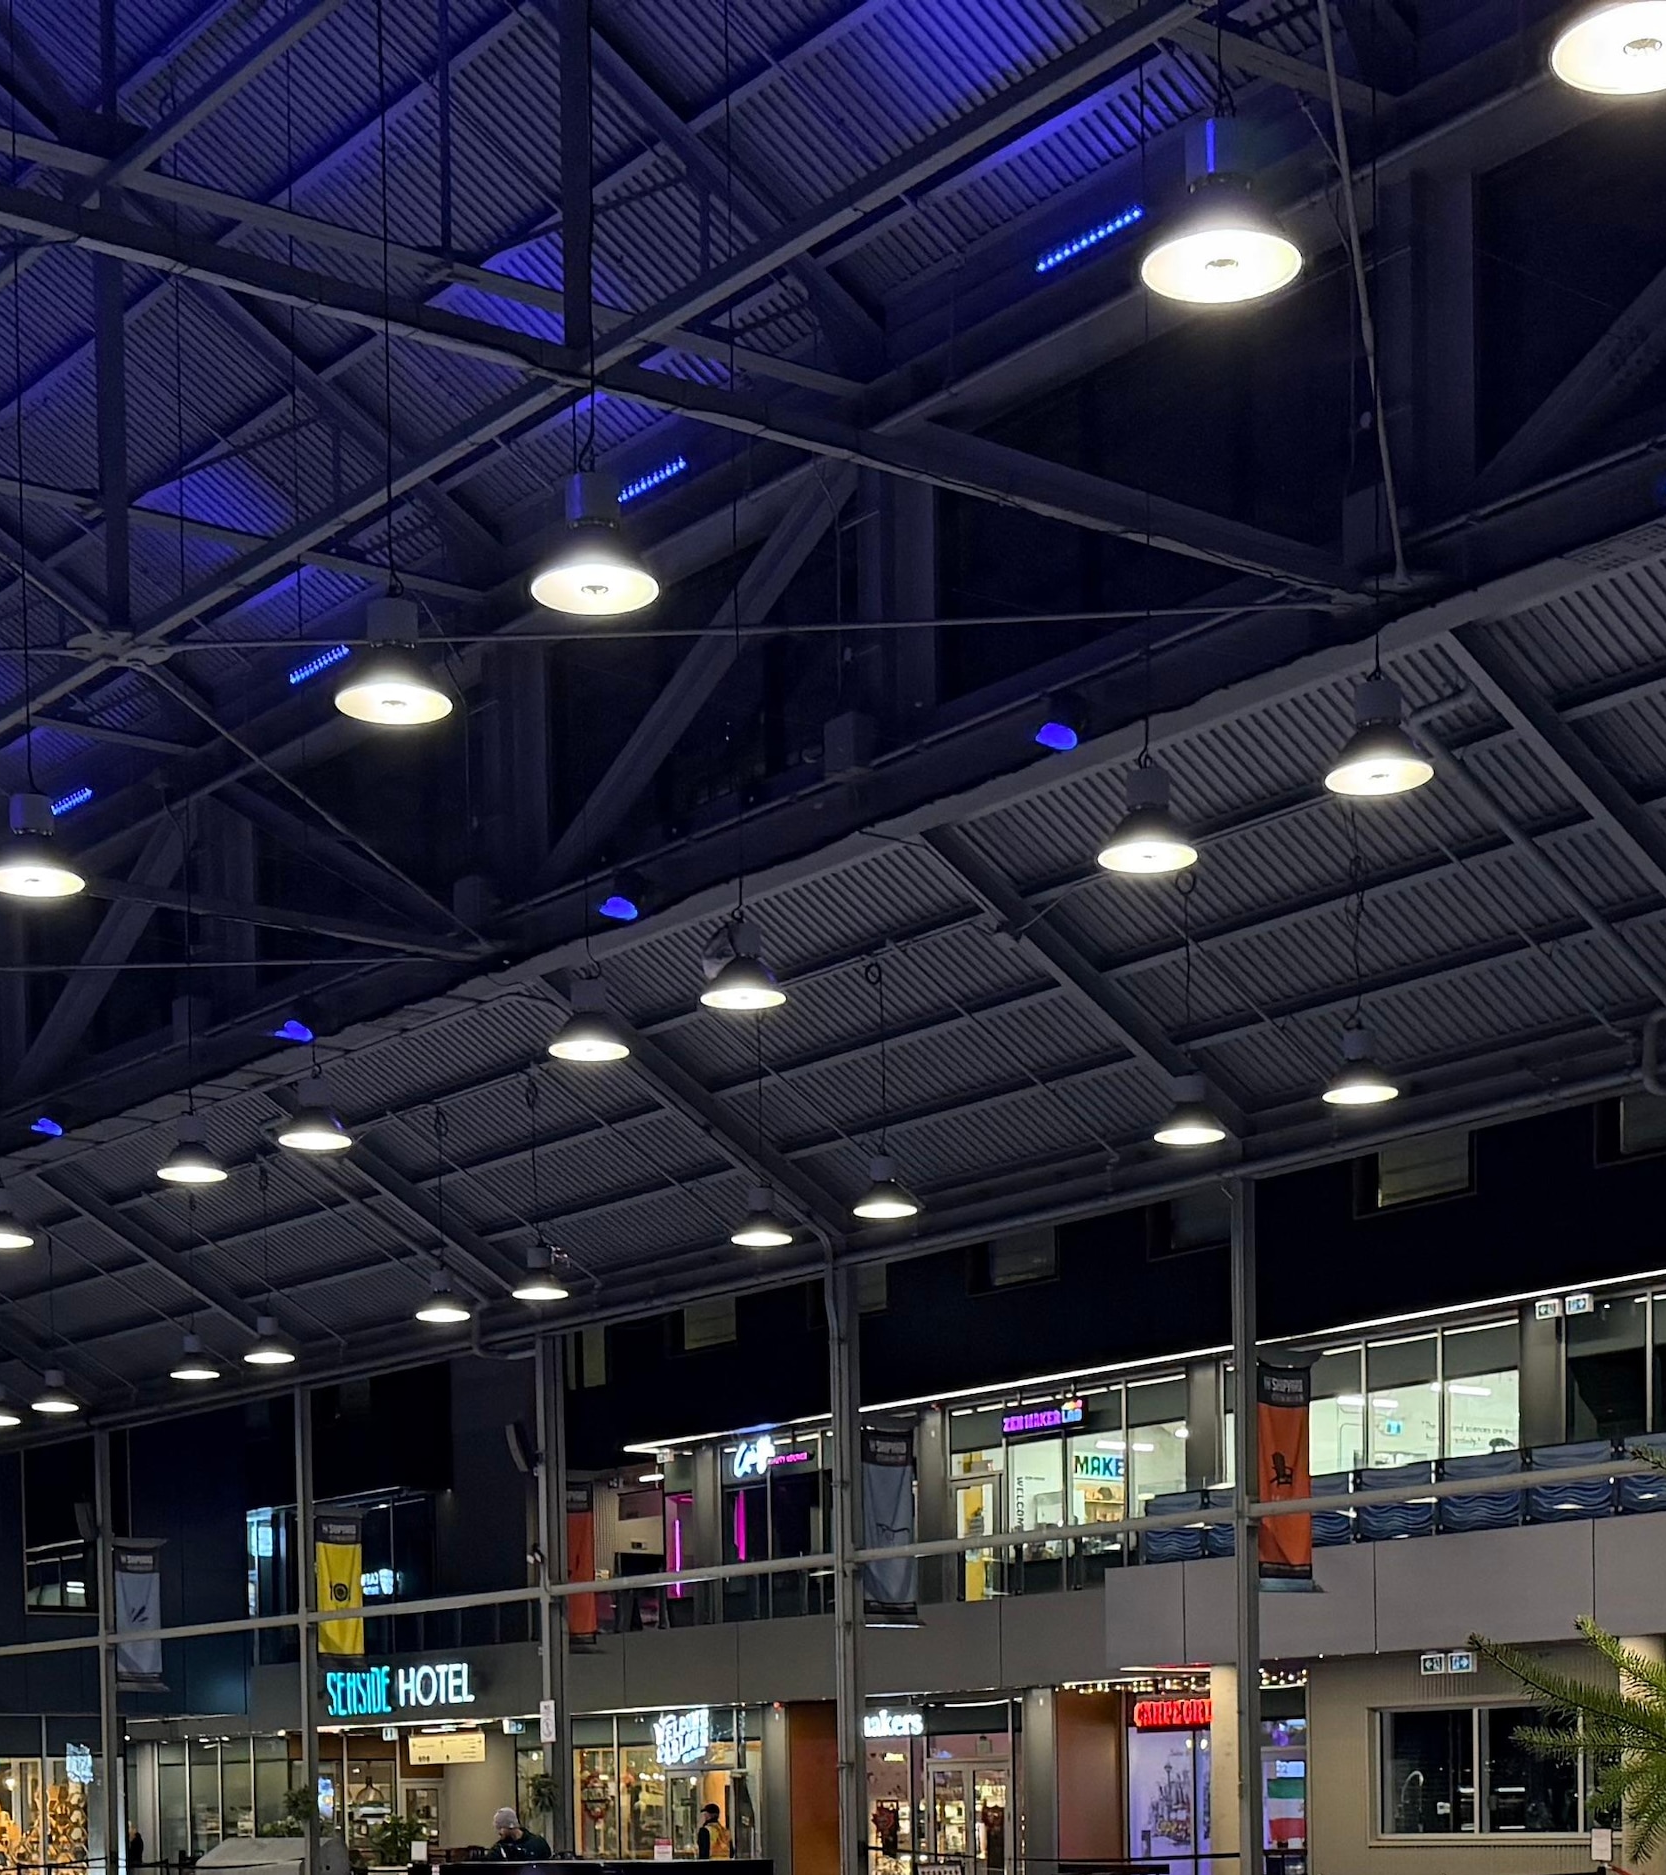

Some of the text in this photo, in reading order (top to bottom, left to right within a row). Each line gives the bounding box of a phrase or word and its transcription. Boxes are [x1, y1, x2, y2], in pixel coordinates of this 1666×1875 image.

[1016, 1476, 1025, 1532] WELCOM
[326, 1662, 476, 1716] SEASIDE HOTEL
